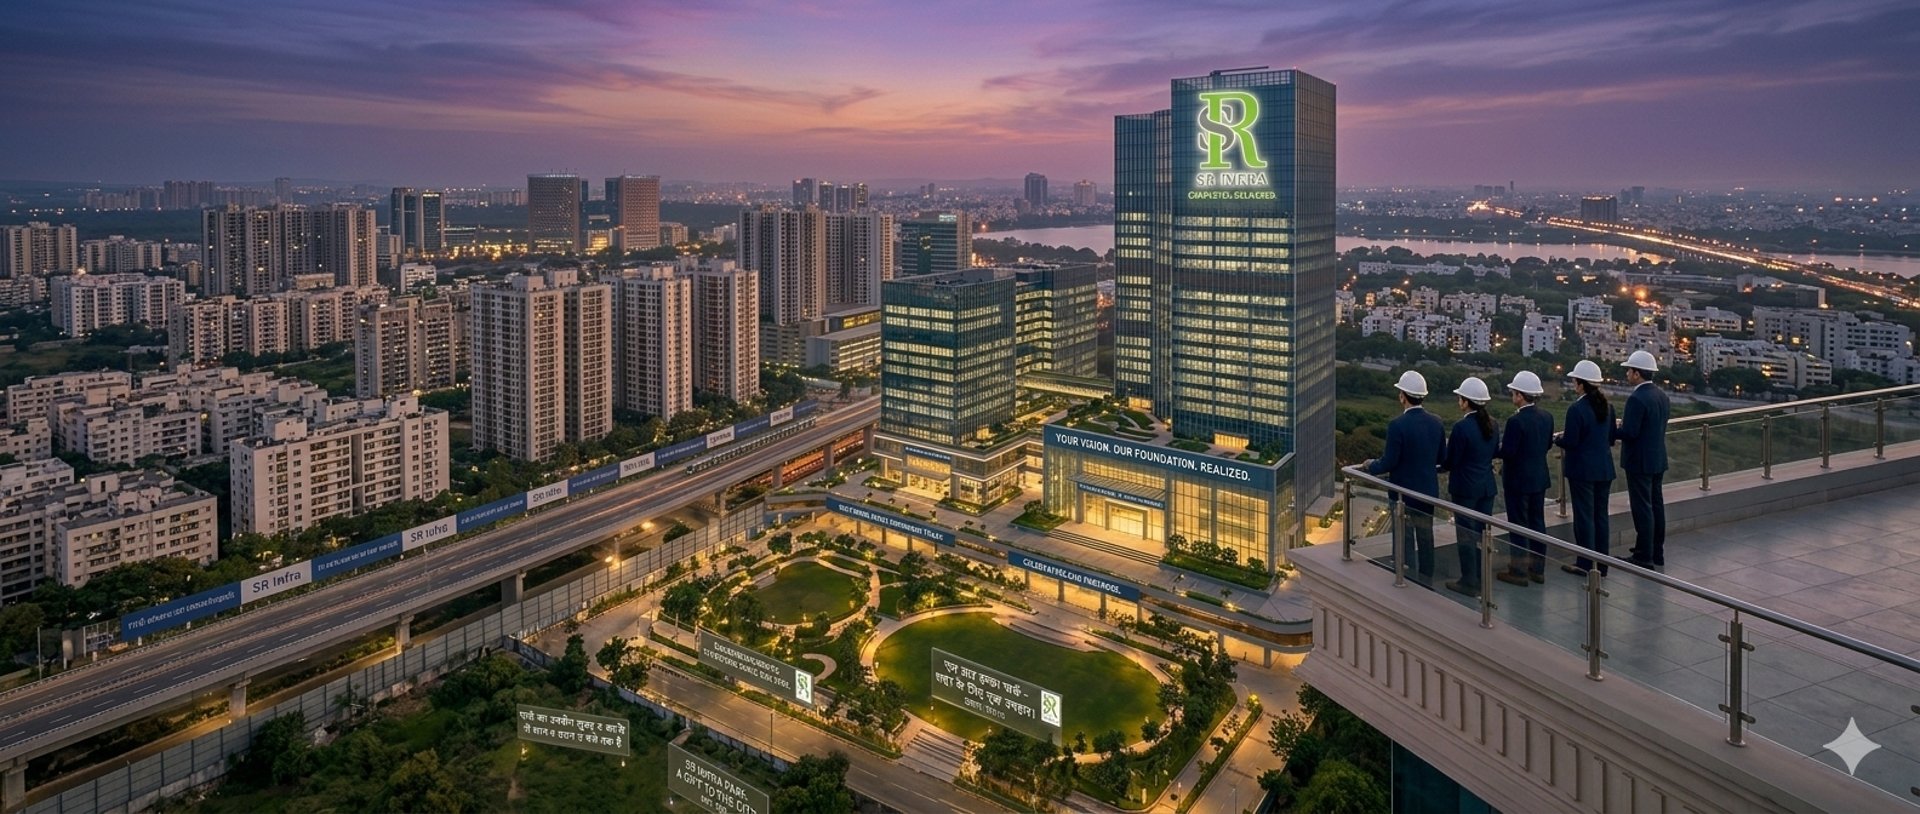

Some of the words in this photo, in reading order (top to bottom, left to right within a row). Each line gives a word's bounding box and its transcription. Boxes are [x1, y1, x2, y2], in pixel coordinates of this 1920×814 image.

[1056, 433, 1079, 447] YOUR
[1114, 444, 1132, 457] OUR
[1200, 462, 1251, 481] REALIZED.
[253, 580, 269, 593] SR
[273, 572, 301, 587] Infra
